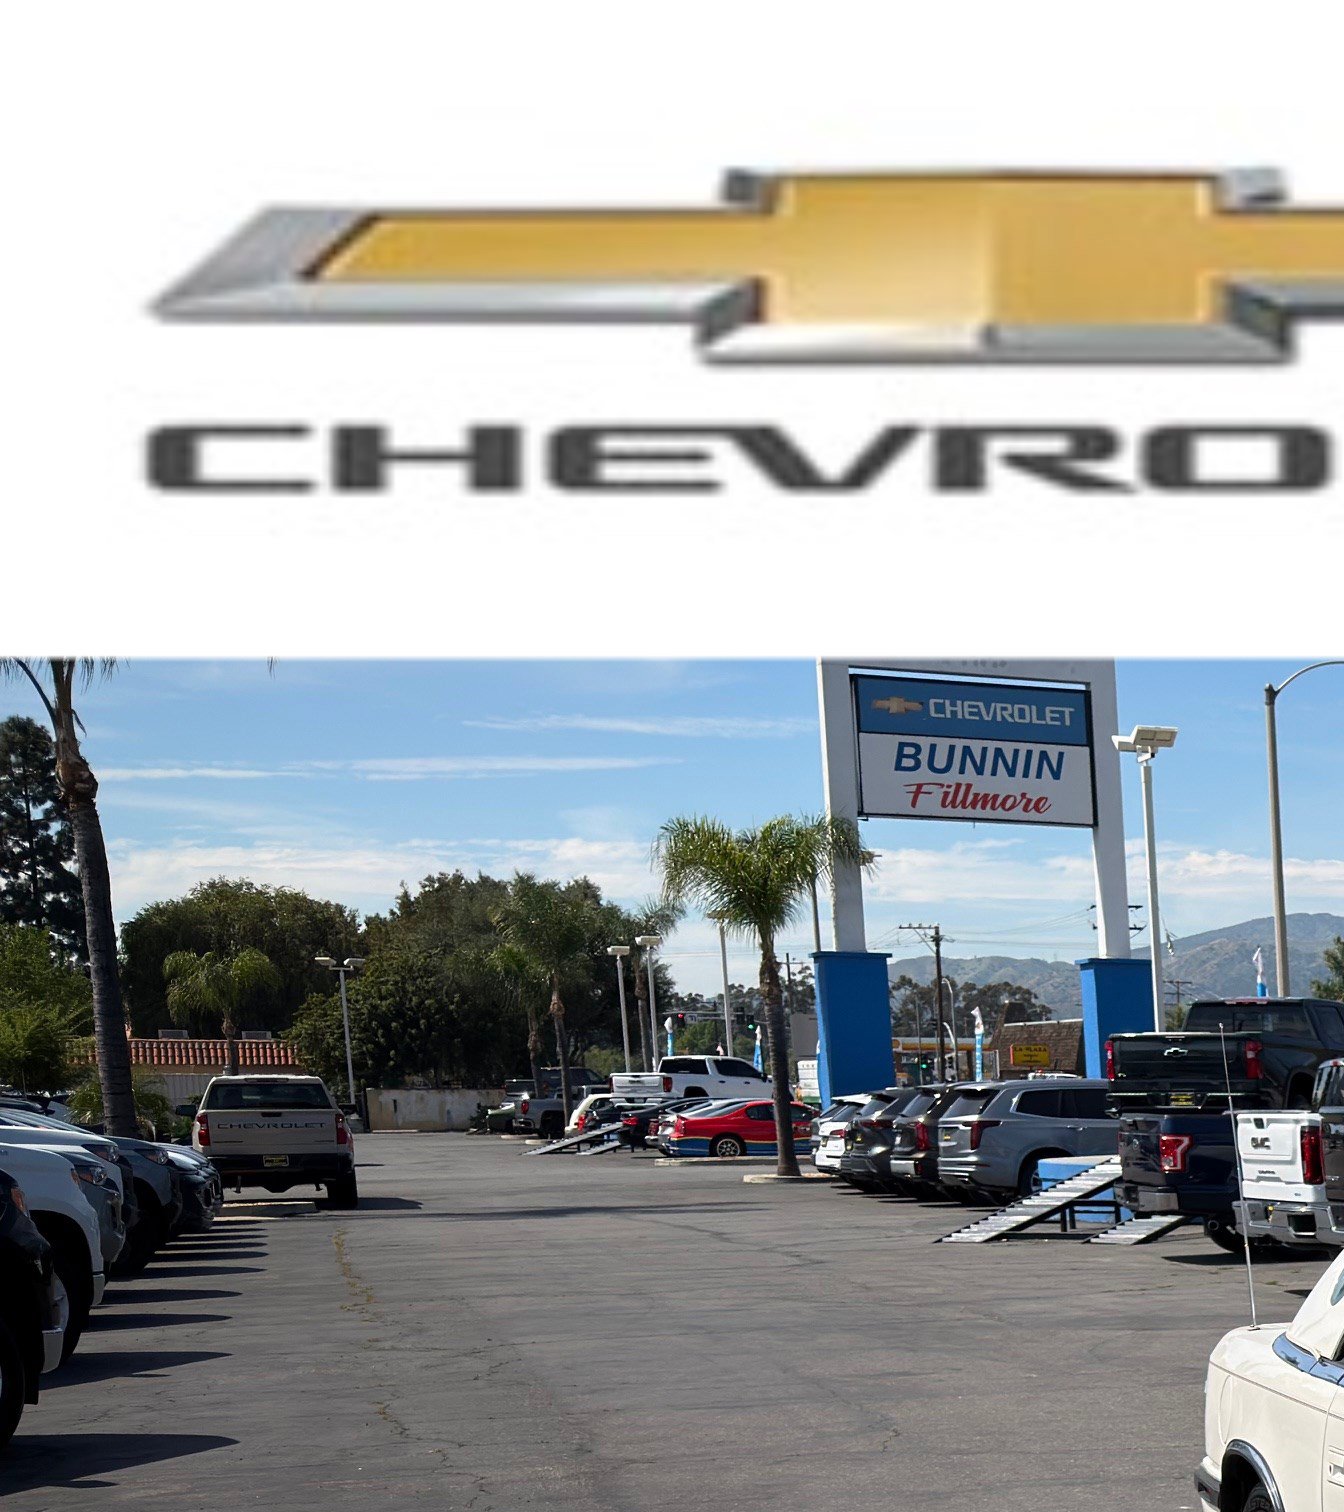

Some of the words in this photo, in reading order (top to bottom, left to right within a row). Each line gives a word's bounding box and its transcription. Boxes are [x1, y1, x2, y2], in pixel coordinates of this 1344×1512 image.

[929, 698, 1075, 726] CHEVROLET
[894, 741, 1065, 780] BUNNIN
[903, 782, 1052, 815] Fillmore
[217, 1122, 325, 1130] CHEVROLET
